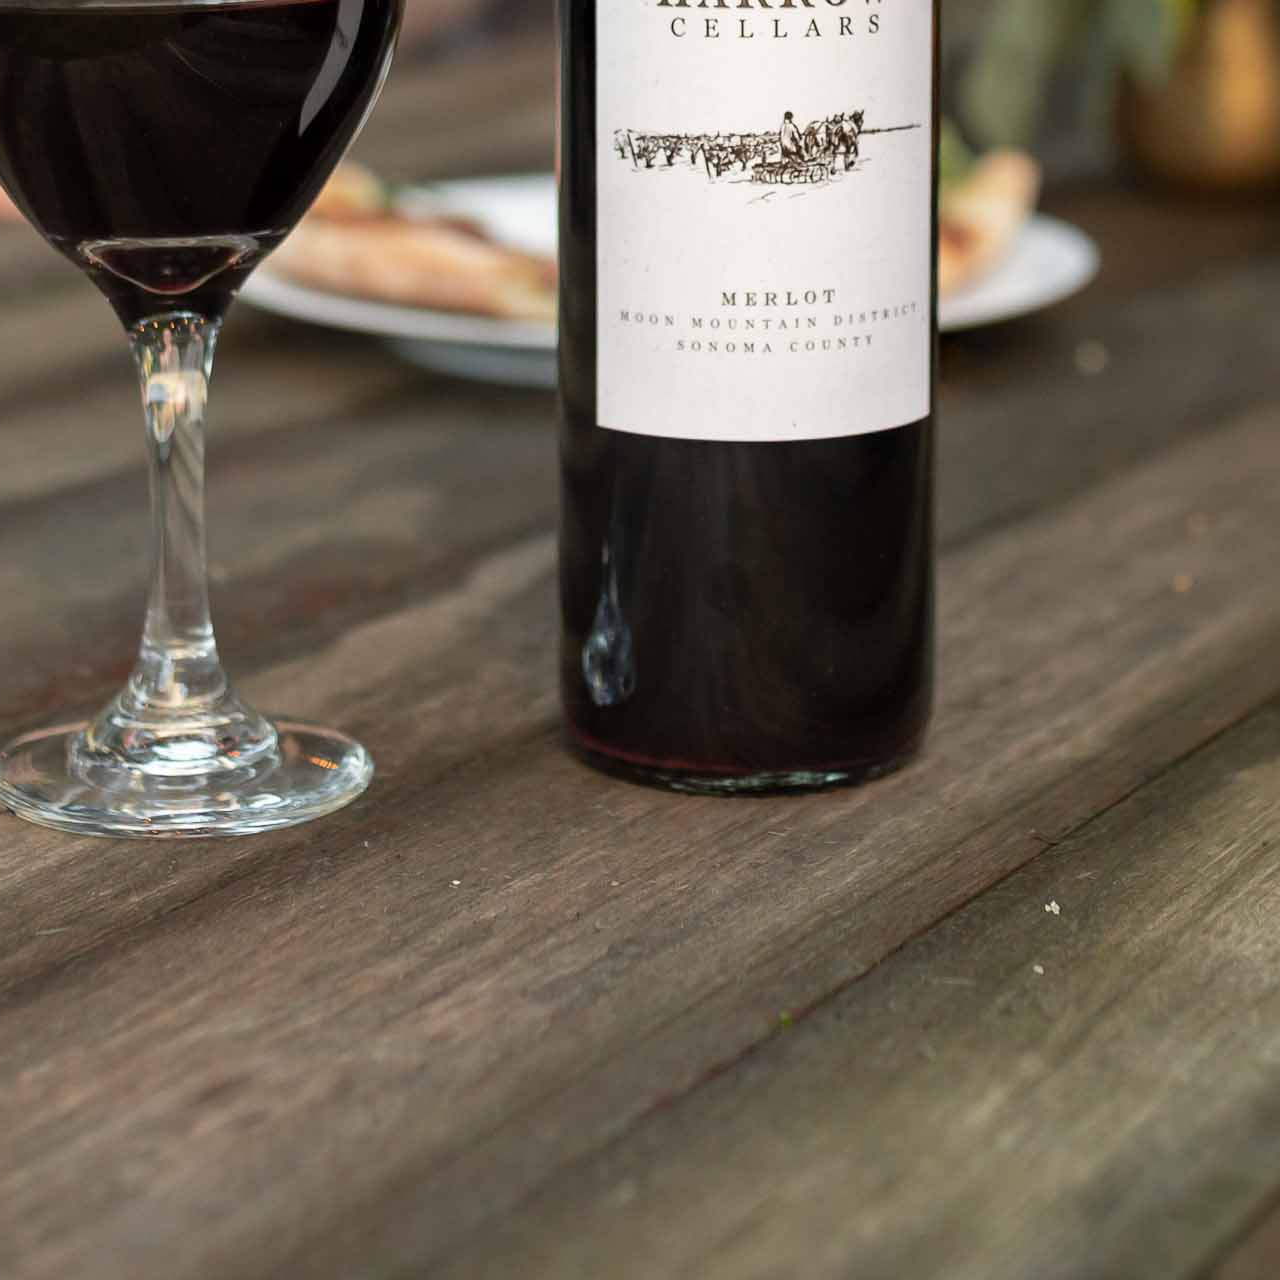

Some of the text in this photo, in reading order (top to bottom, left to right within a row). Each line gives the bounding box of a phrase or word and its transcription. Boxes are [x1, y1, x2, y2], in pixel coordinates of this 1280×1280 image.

[670, 14, 880, 38] CELLARS
[721, 289, 837, 307] MERLOT
[619, 301, 919, 330] MOON MOUNTAIN DISTRICT
[676, 335, 874, 353] SONOMA COUNTY
